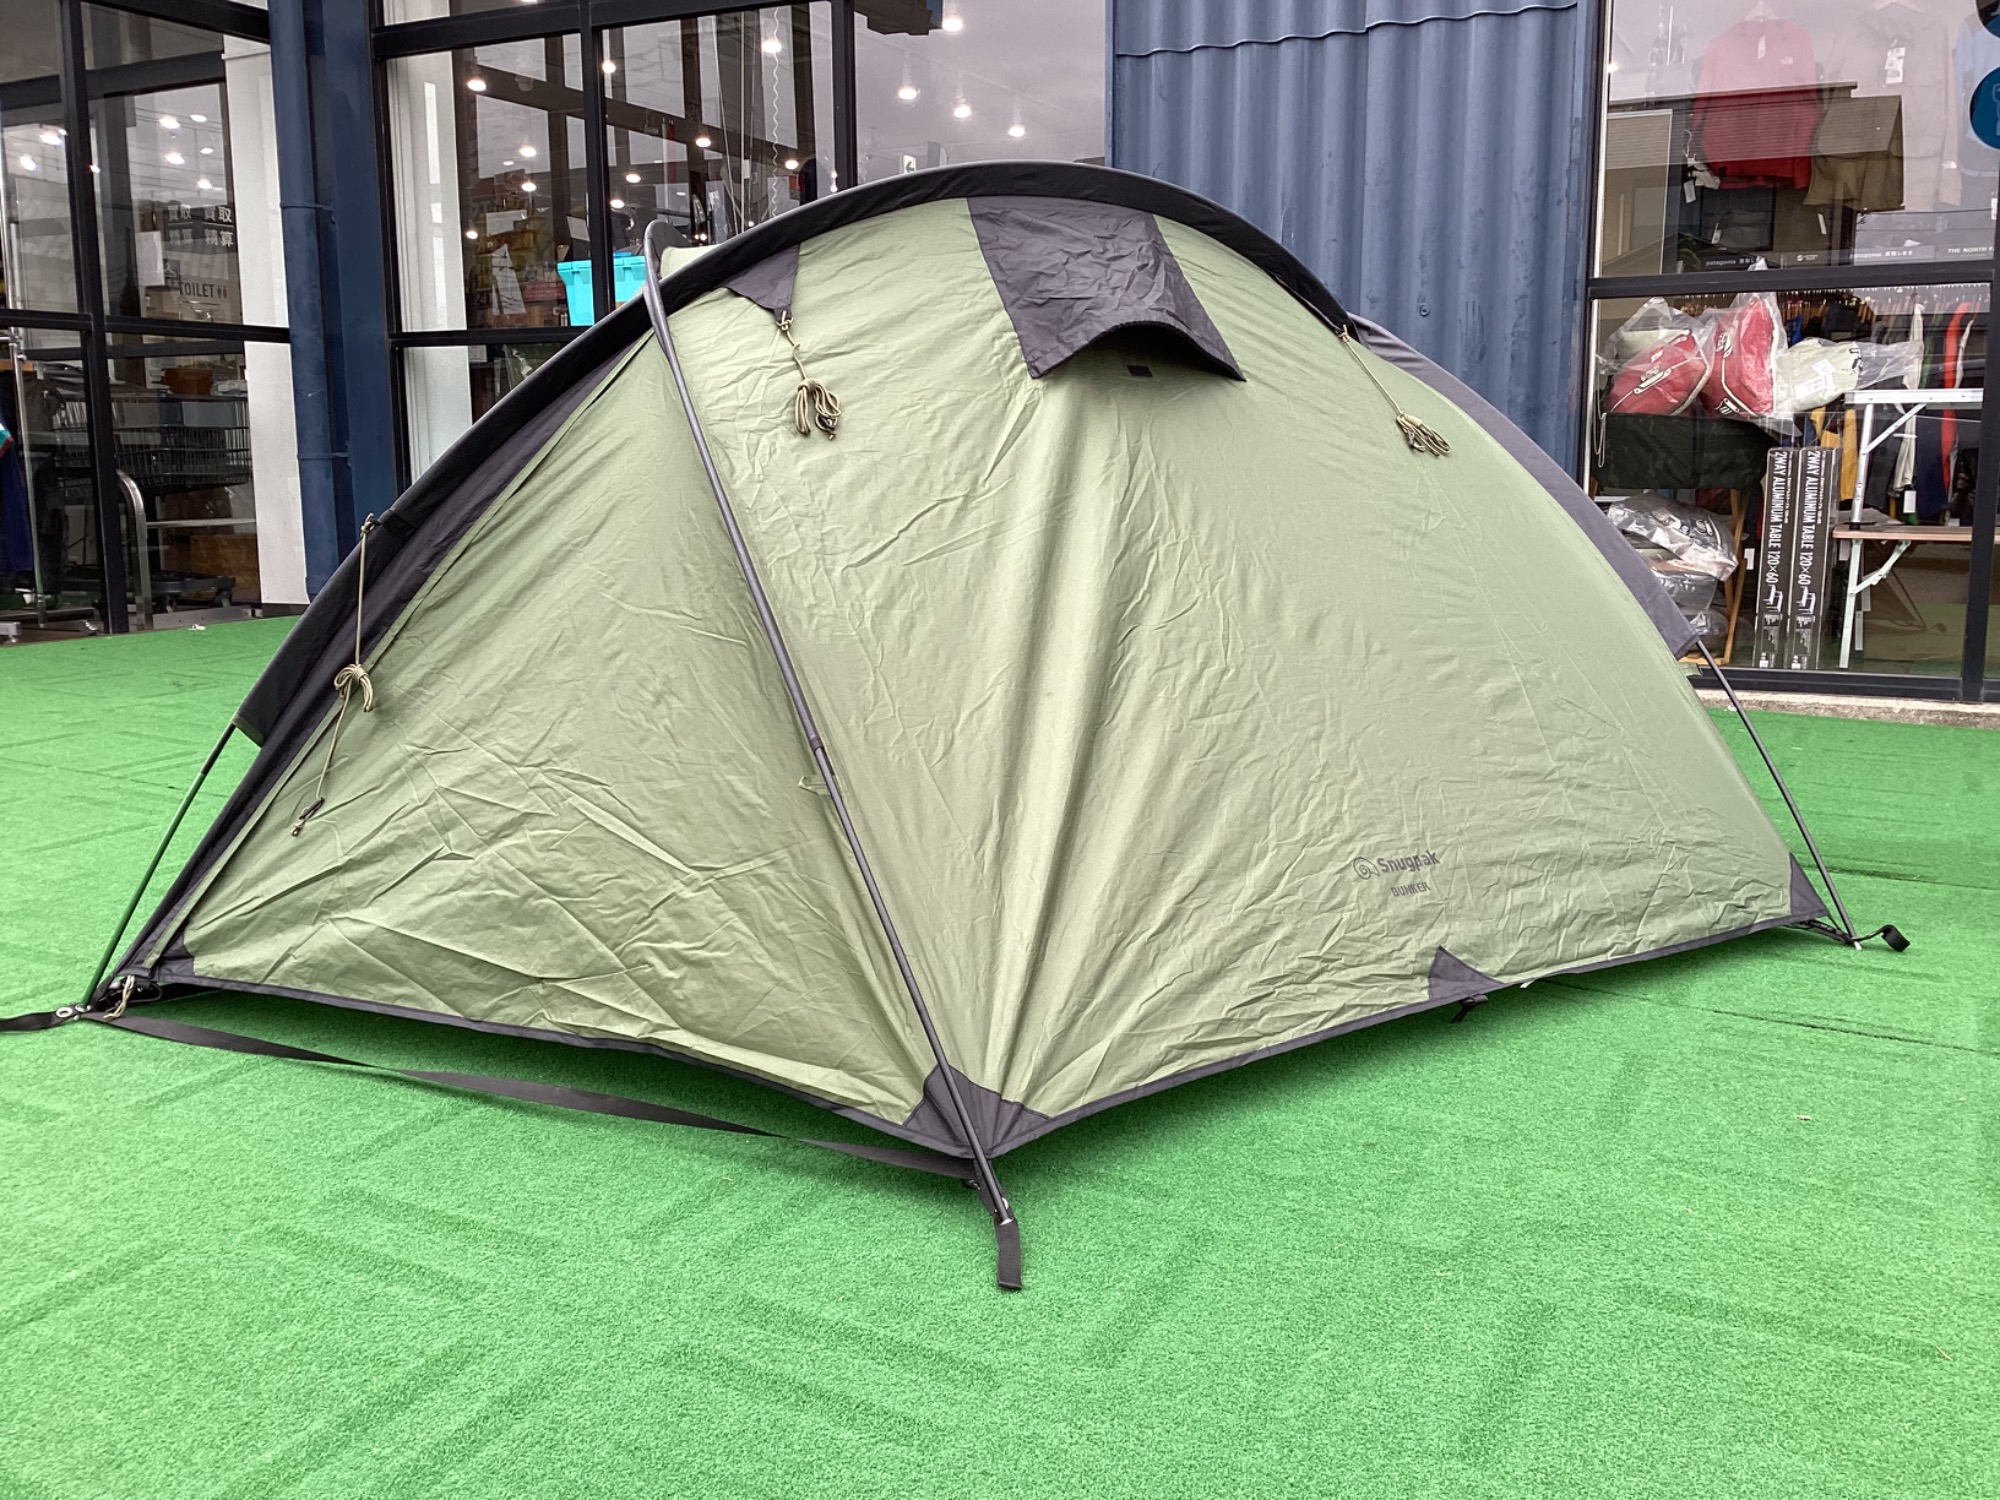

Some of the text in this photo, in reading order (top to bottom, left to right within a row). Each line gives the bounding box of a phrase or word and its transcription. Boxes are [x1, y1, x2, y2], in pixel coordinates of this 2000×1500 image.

[1773, 451, 1788, 475] 2WAY
[1806, 450, 1821, 475] 2WAY
[1770, 476, 1786, 523] ALUMINUM
[1802, 476, 1819, 523] ALUMINUM
[1767, 523, 1783, 548] TABLE
[1800, 524, 1816, 549] TABLE
[1377, 850, 1440, 873] Snugpak
[1390, 881, 1431, 897] BUNKER
